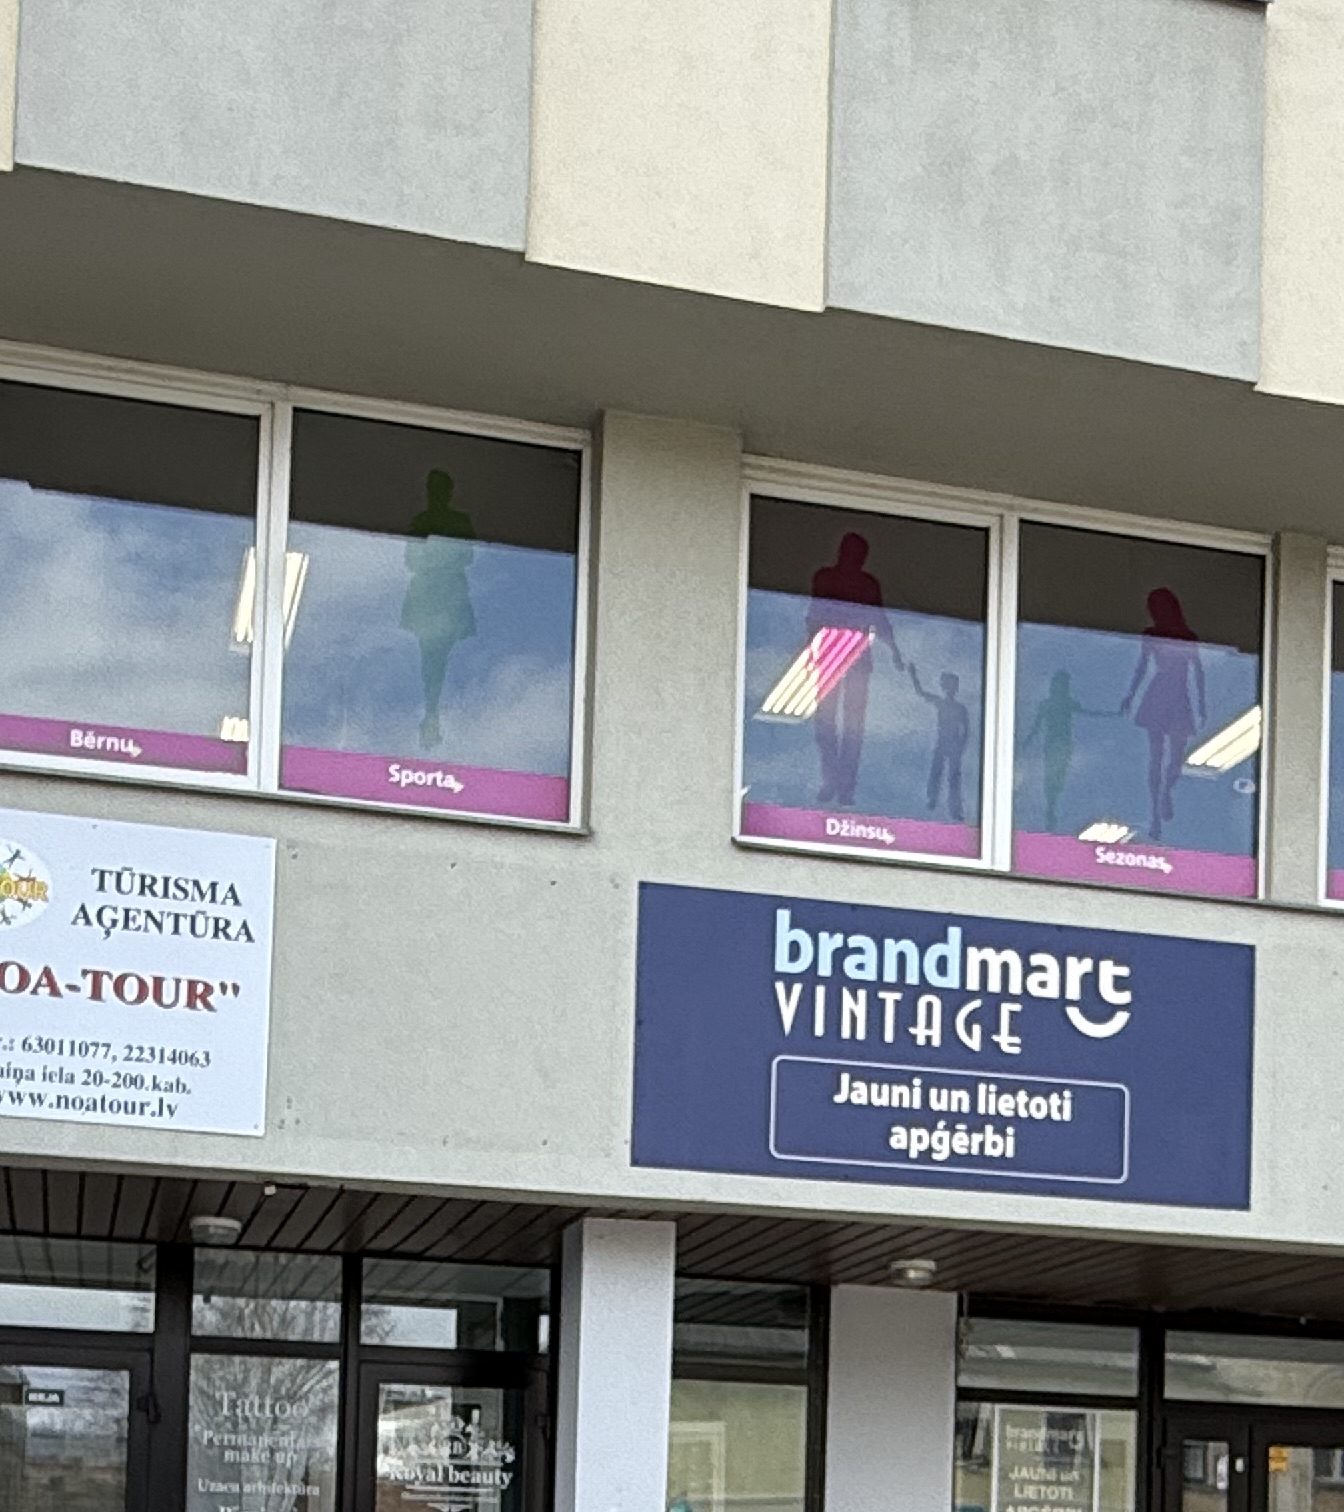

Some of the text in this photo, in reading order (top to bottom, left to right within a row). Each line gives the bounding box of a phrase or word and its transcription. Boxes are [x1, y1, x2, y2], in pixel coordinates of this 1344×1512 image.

[70, 728, 135, 754] Bērnu
[388, 763, 456, 789] Sporta
[1095, 846, 1166, 870] Sezonas
[90, 866, 243, 907] TŪRISMA
[70, 902, 256, 944] AĢENTŪRA
[773, 909, 1133, 1006] brandmart
[774, 981, 1023, 1055] VINTAGE
[122, 1043, 212, 1069] 22314063
[42, 1062, 76, 1086] iela
[833, 1073, 1073, 1122] Jauni un lietoti
[889, 1120, 1016, 1162] apģērbi
[214, 1391, 310, 1418] Tattoo
[449, 1462, 514, 1490] beauty
